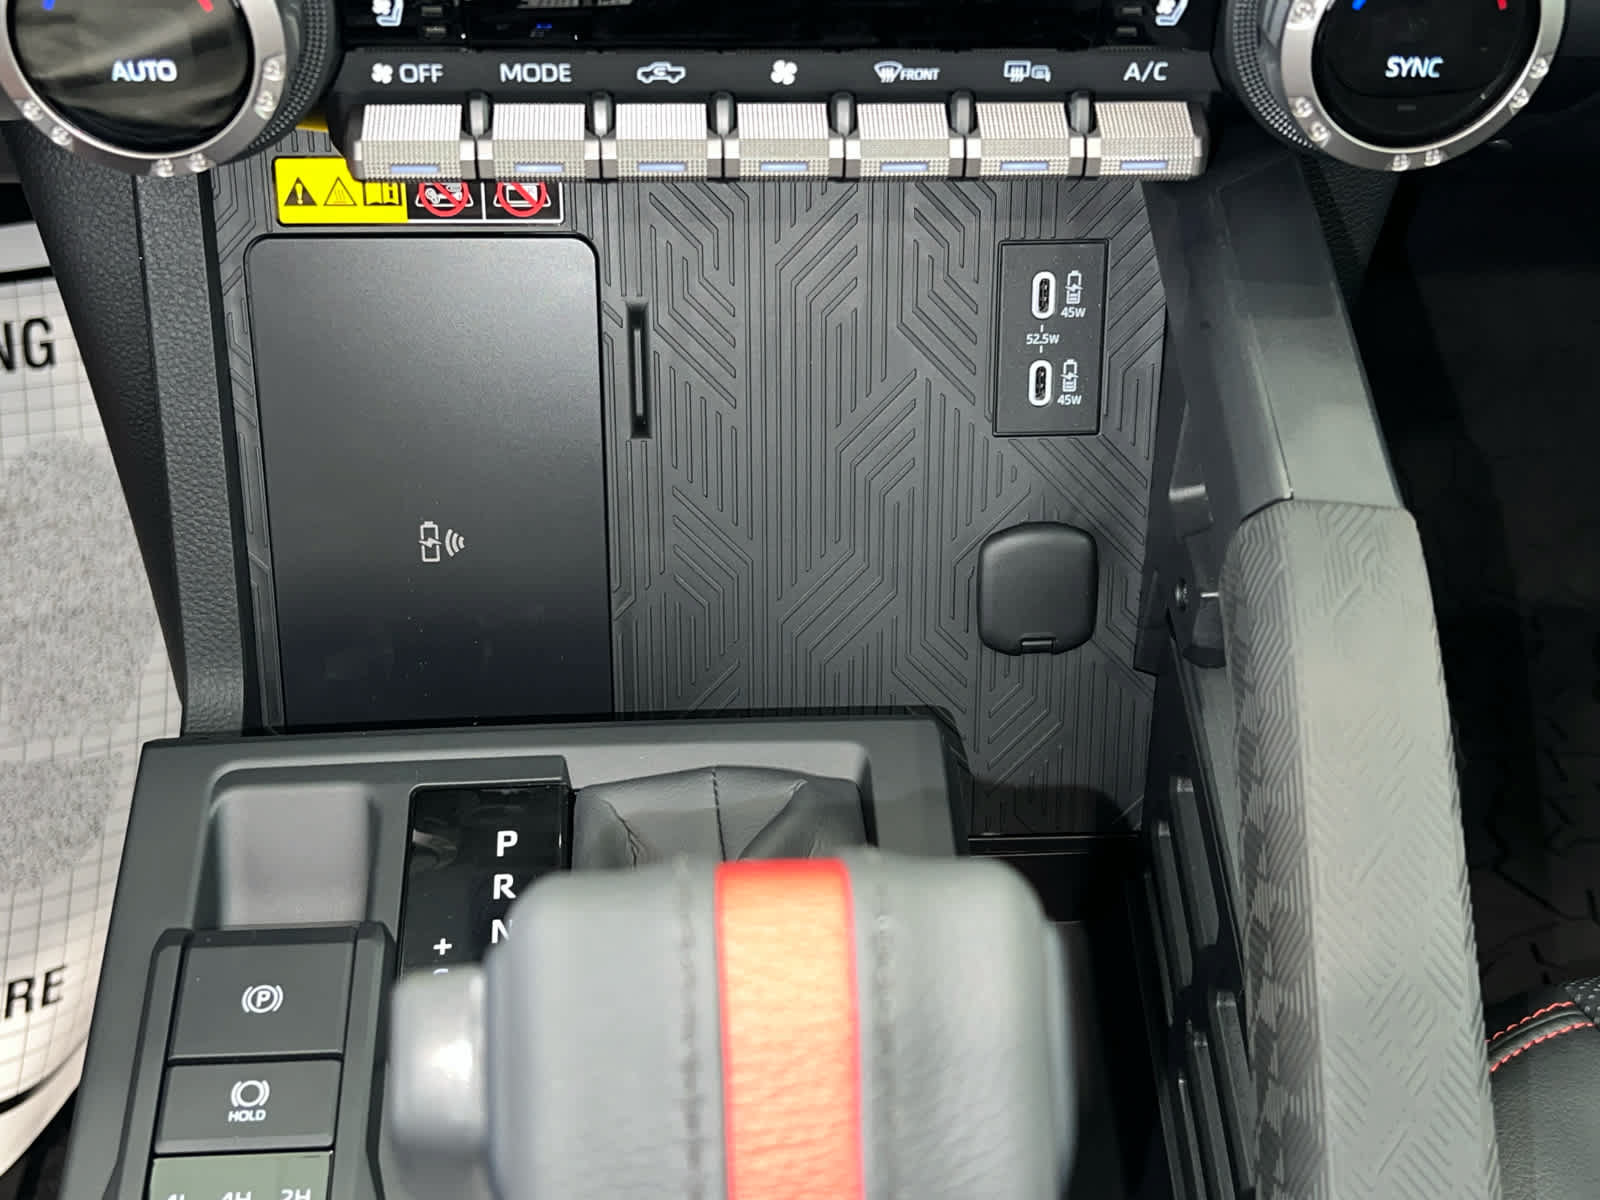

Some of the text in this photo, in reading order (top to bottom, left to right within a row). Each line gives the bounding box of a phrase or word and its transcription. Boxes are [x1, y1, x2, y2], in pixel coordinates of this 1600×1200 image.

[111, 59, 178, 82] AUTO
[400, 63, 443, 83] OFF
[500, 63, 572, 83] MODE
[899, 68, 940, 81] FRONT
[1123, 62, 1169, 82] A/C
[1385, 55, 1444, 79] SYNC
[1060, 306, 1086, 319] 45W
[1026, 333, 1060, 346] 52.5W
[1057, 394, 1082, 406] 45W
[496, 830, 518, 857] P
[493, 873, 516, 900] R
[4, 962, 68, 1019] RE
[228, 1109, 266, 1122] HOLD
[280, 1188, 312, 1200] 2H
